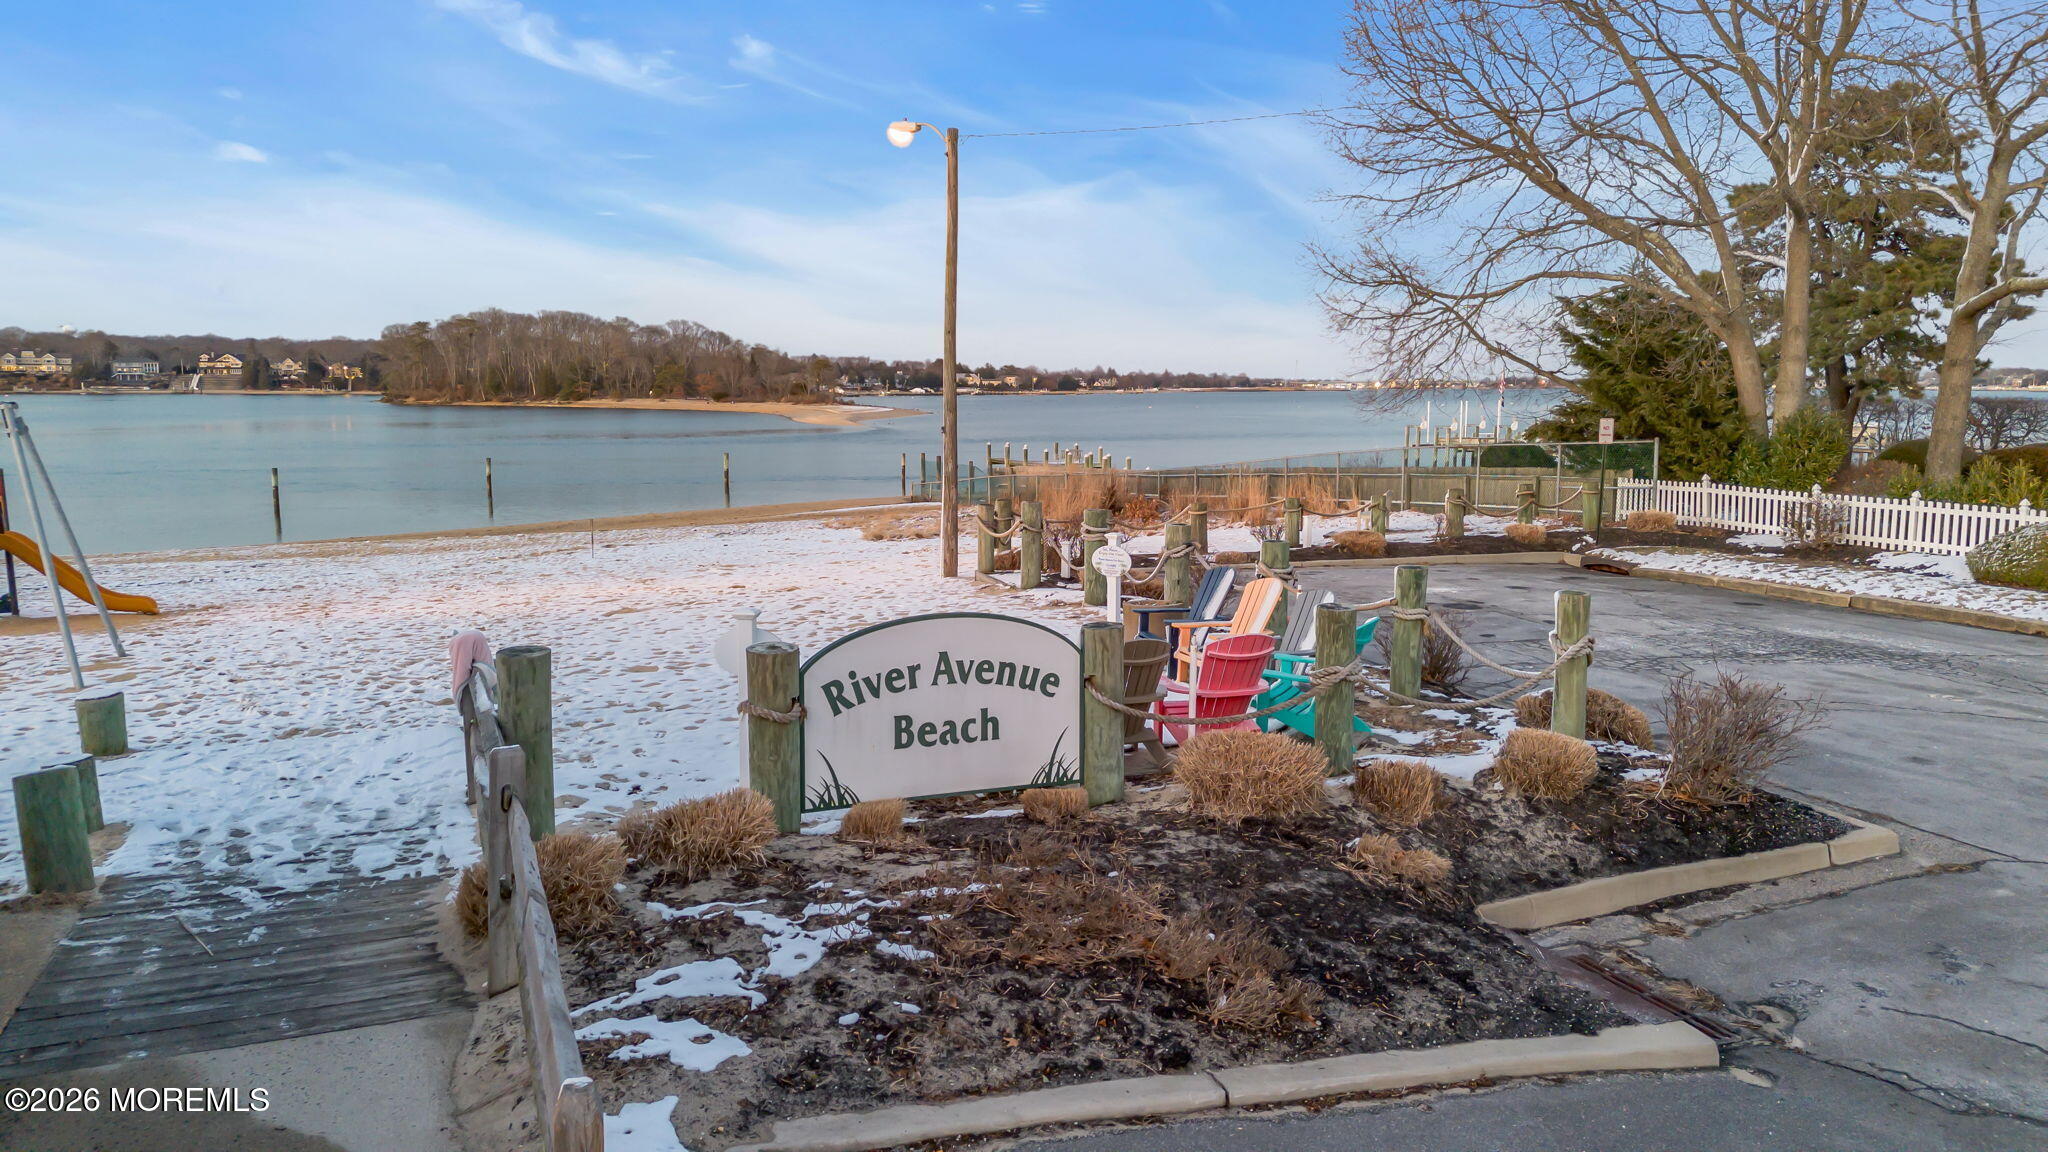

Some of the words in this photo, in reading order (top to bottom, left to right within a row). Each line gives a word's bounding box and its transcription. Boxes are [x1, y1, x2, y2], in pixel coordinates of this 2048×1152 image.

[820, 663, 921, 717] River
[931, 651, 1060, 698] Avenue
[893, 708, 1000, 750] Beach
